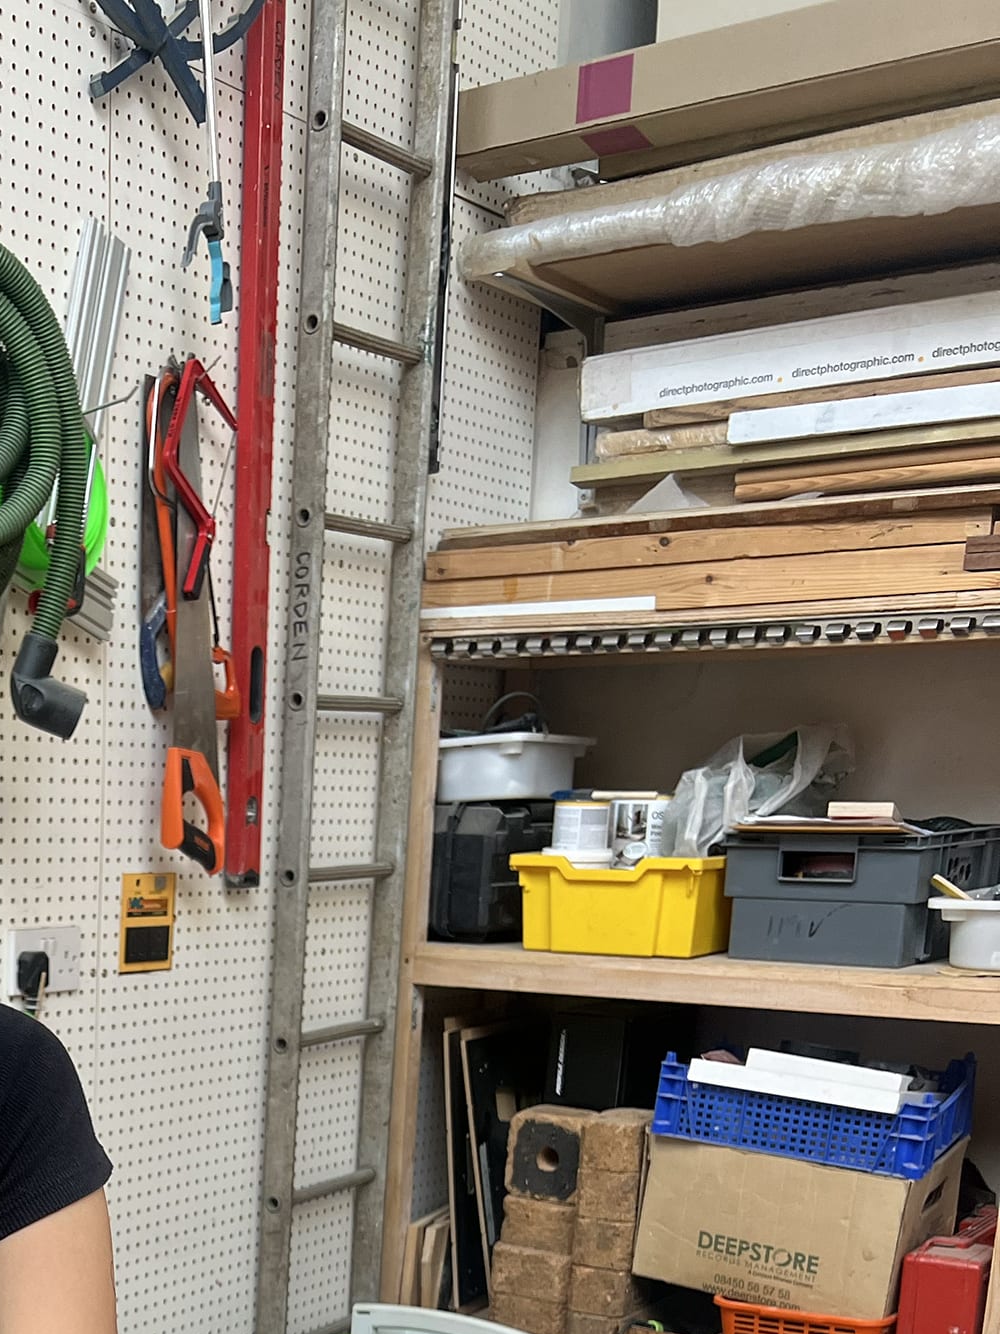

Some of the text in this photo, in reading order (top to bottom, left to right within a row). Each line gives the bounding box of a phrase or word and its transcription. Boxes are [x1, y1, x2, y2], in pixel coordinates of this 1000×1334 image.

[659, 372, 773, 398] directphotographic.com
[792, 352, 915, 378] directphotographic.com
[291, 551, 311, 661] CORDEN
[696, 1250, 740, 1266] RECORDS
[744, 1260, 816, 1283] MANAGEMENT
[697, 1230, 819, 1274] DEEPSTORE
